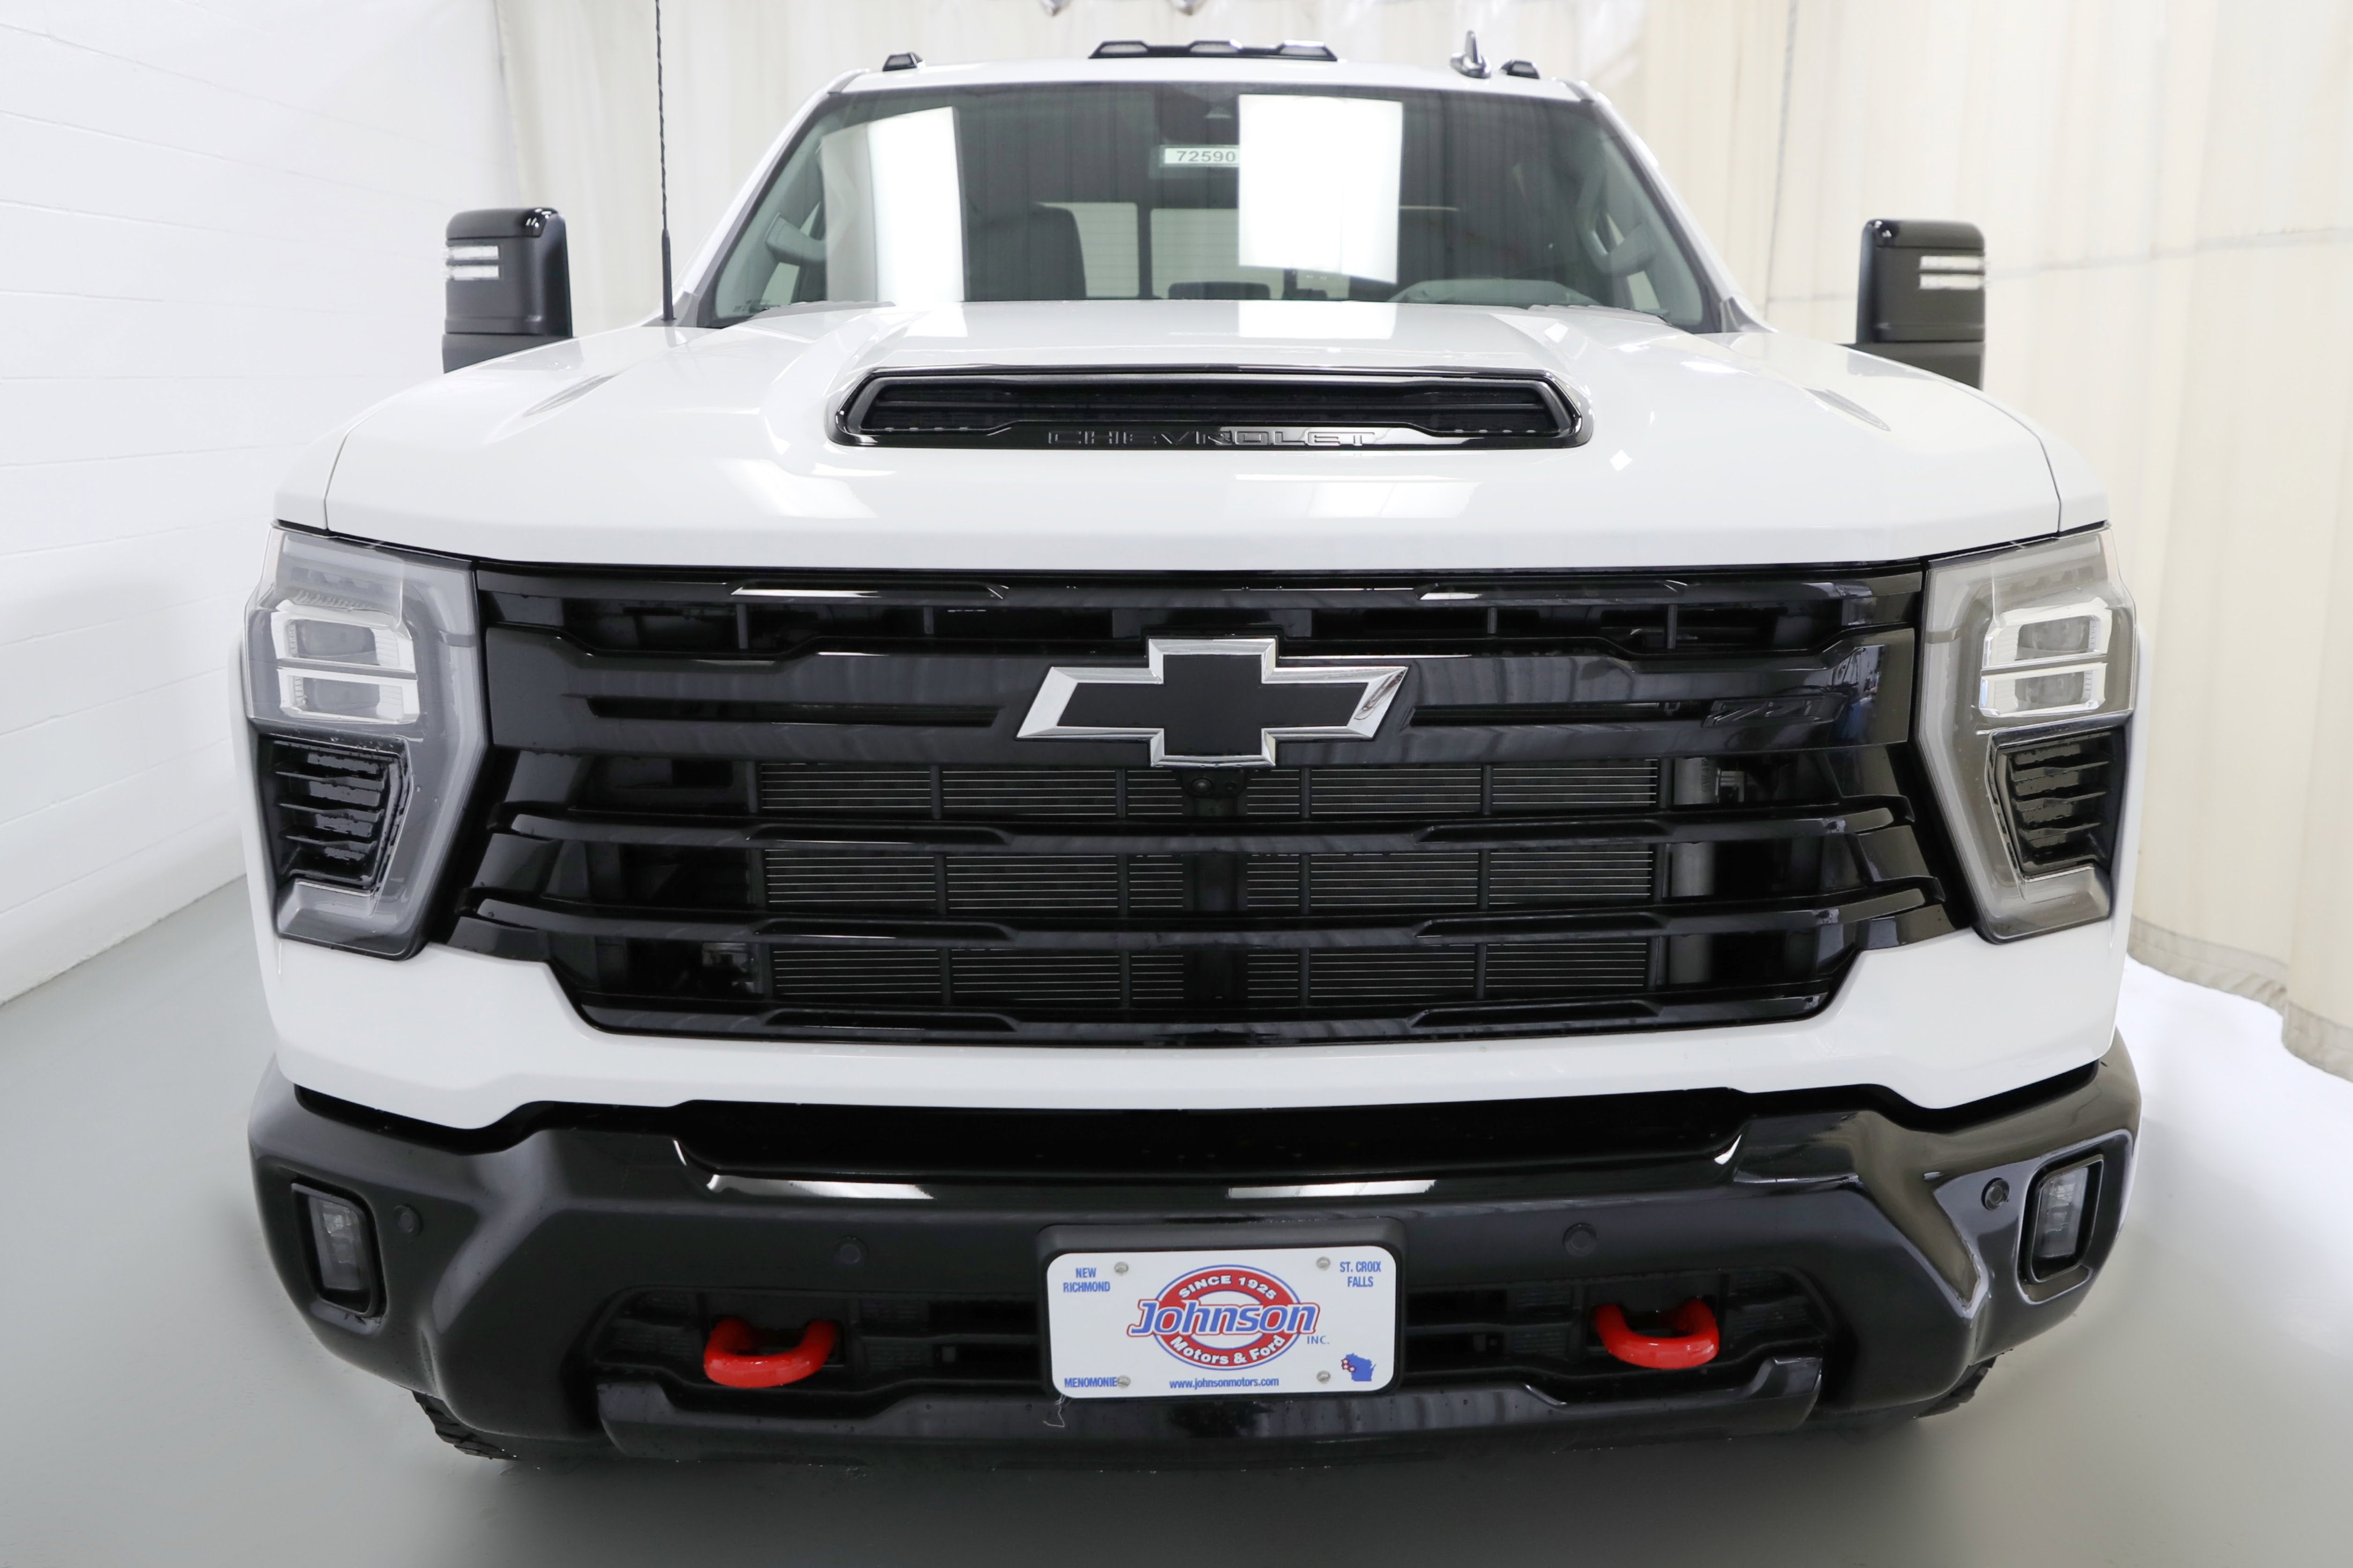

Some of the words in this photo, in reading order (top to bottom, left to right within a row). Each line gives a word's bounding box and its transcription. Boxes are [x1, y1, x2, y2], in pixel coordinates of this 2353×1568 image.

[1176, 150, 1237, 162] 72590
[1047, 430, 1375, 446] CHEVROLET
[1076, 1267, 1097, 1278] NEW
[1340, 1261, 1353, 1273] ST.
[1356, 1261, 1381, 1273] CROIX
[1063, 1281, 1111, 1292] RICHMOND
[1179, 1275, 1232, 1298] SINCE
[1238, 1276, 1277, 1300] 1925
[1348, 1276, 1374, 1287] FALLS
[1128, 1299, 1320, 1337] Johnson
[1307, 1335, 1330, 1344] INC.
[1170, 1336, 1230, 1365] Motors
[1233, 1352, 1247, 1364] &
[1248, 1334, 1286, 1361] Ford
[1064, 1377, 1118, 1388] MENOMONIE
[1169, 1377, 1279, 1390] www.johnsonmotors.com
